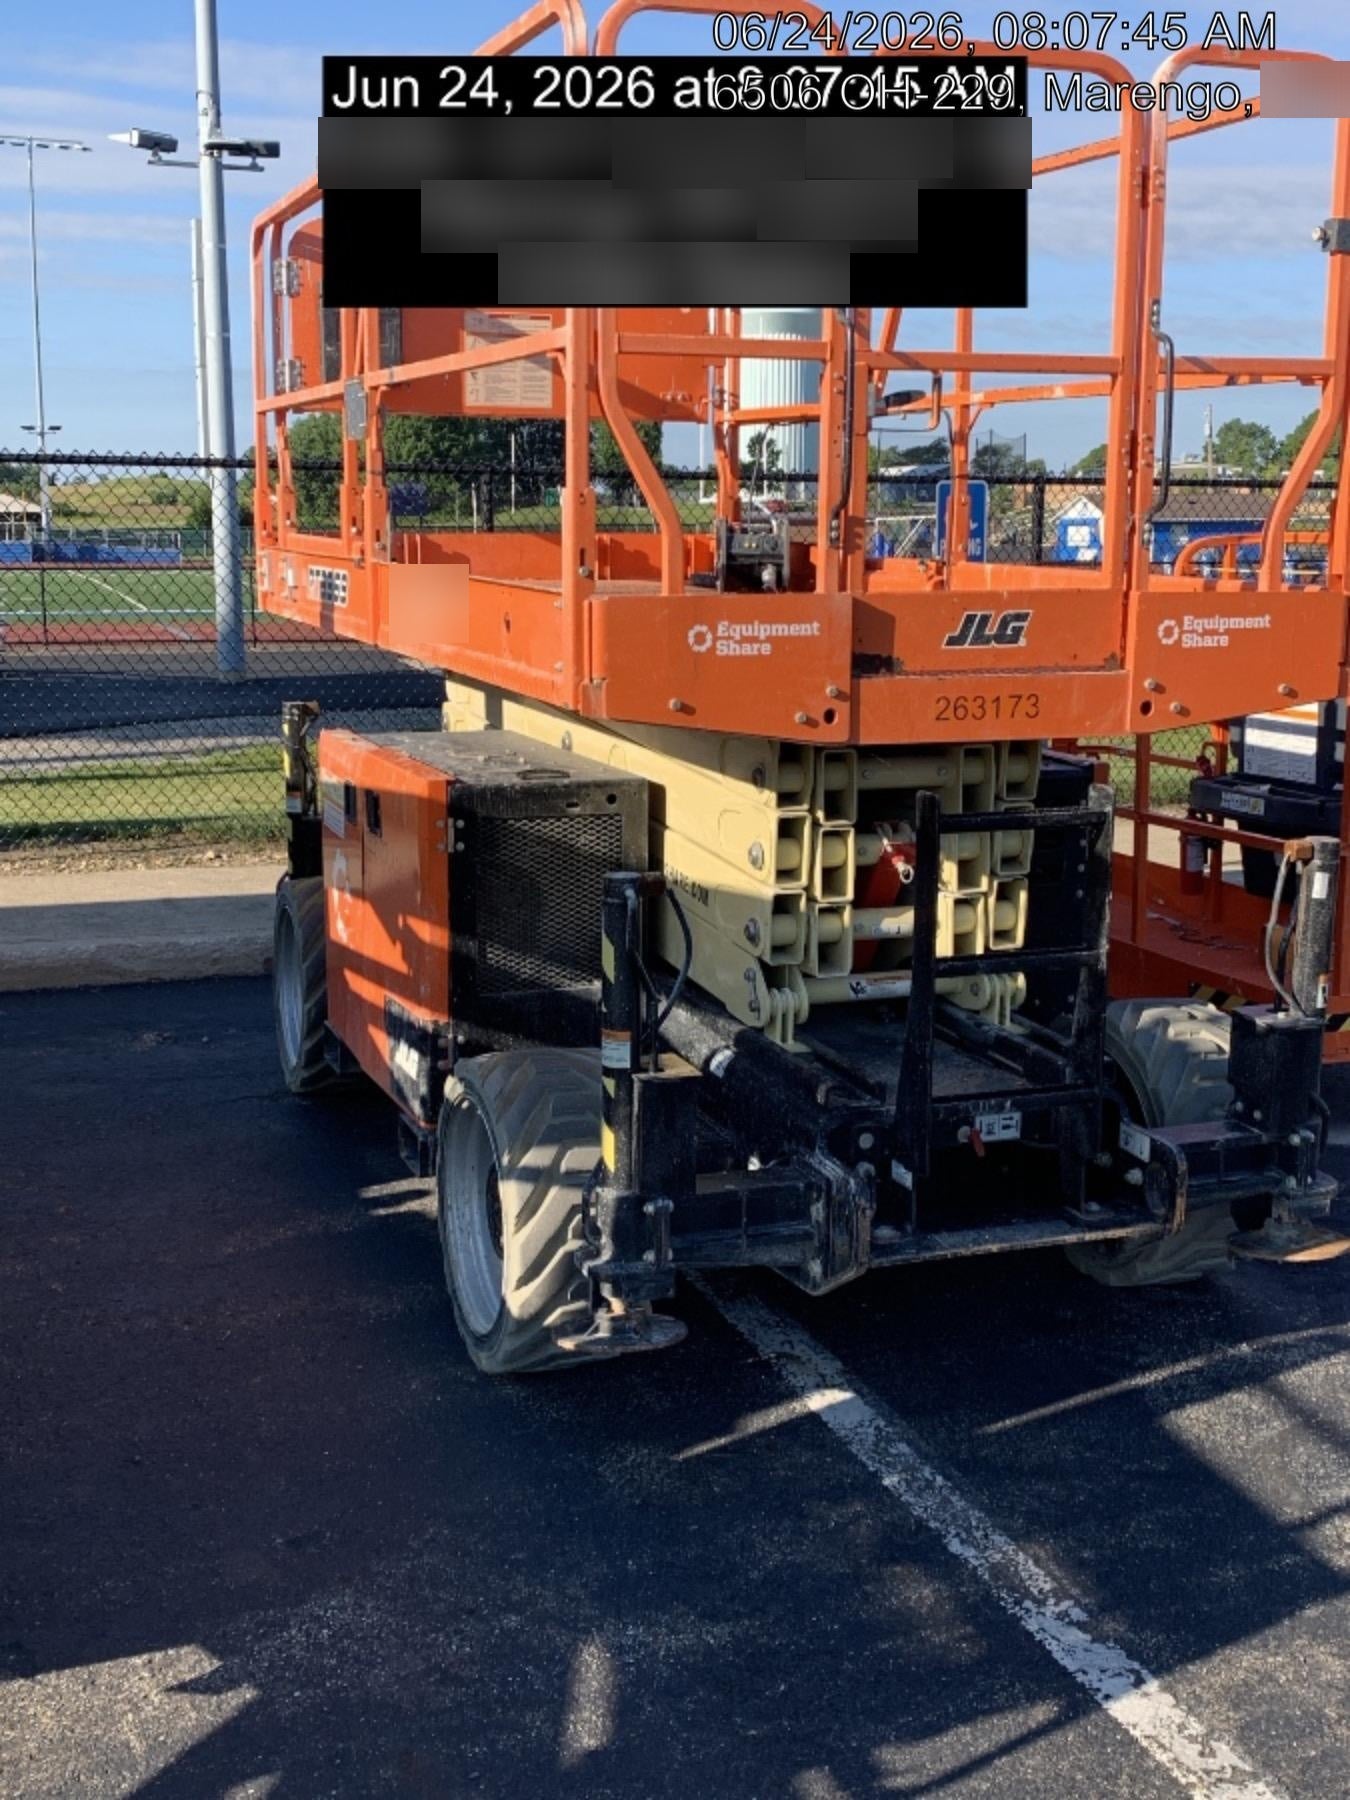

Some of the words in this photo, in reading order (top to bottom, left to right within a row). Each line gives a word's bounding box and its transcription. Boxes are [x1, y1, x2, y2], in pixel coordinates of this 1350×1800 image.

[716, 620, 820, 642] Equipment
[942, 609, 1033, 649] JLG
[1182, 614, 1271, 632] Equipment
[715, 640, 772, 656] Share
[1181, 634, 1229, 648] Share
[934, 694, 1041, 721] 263173
